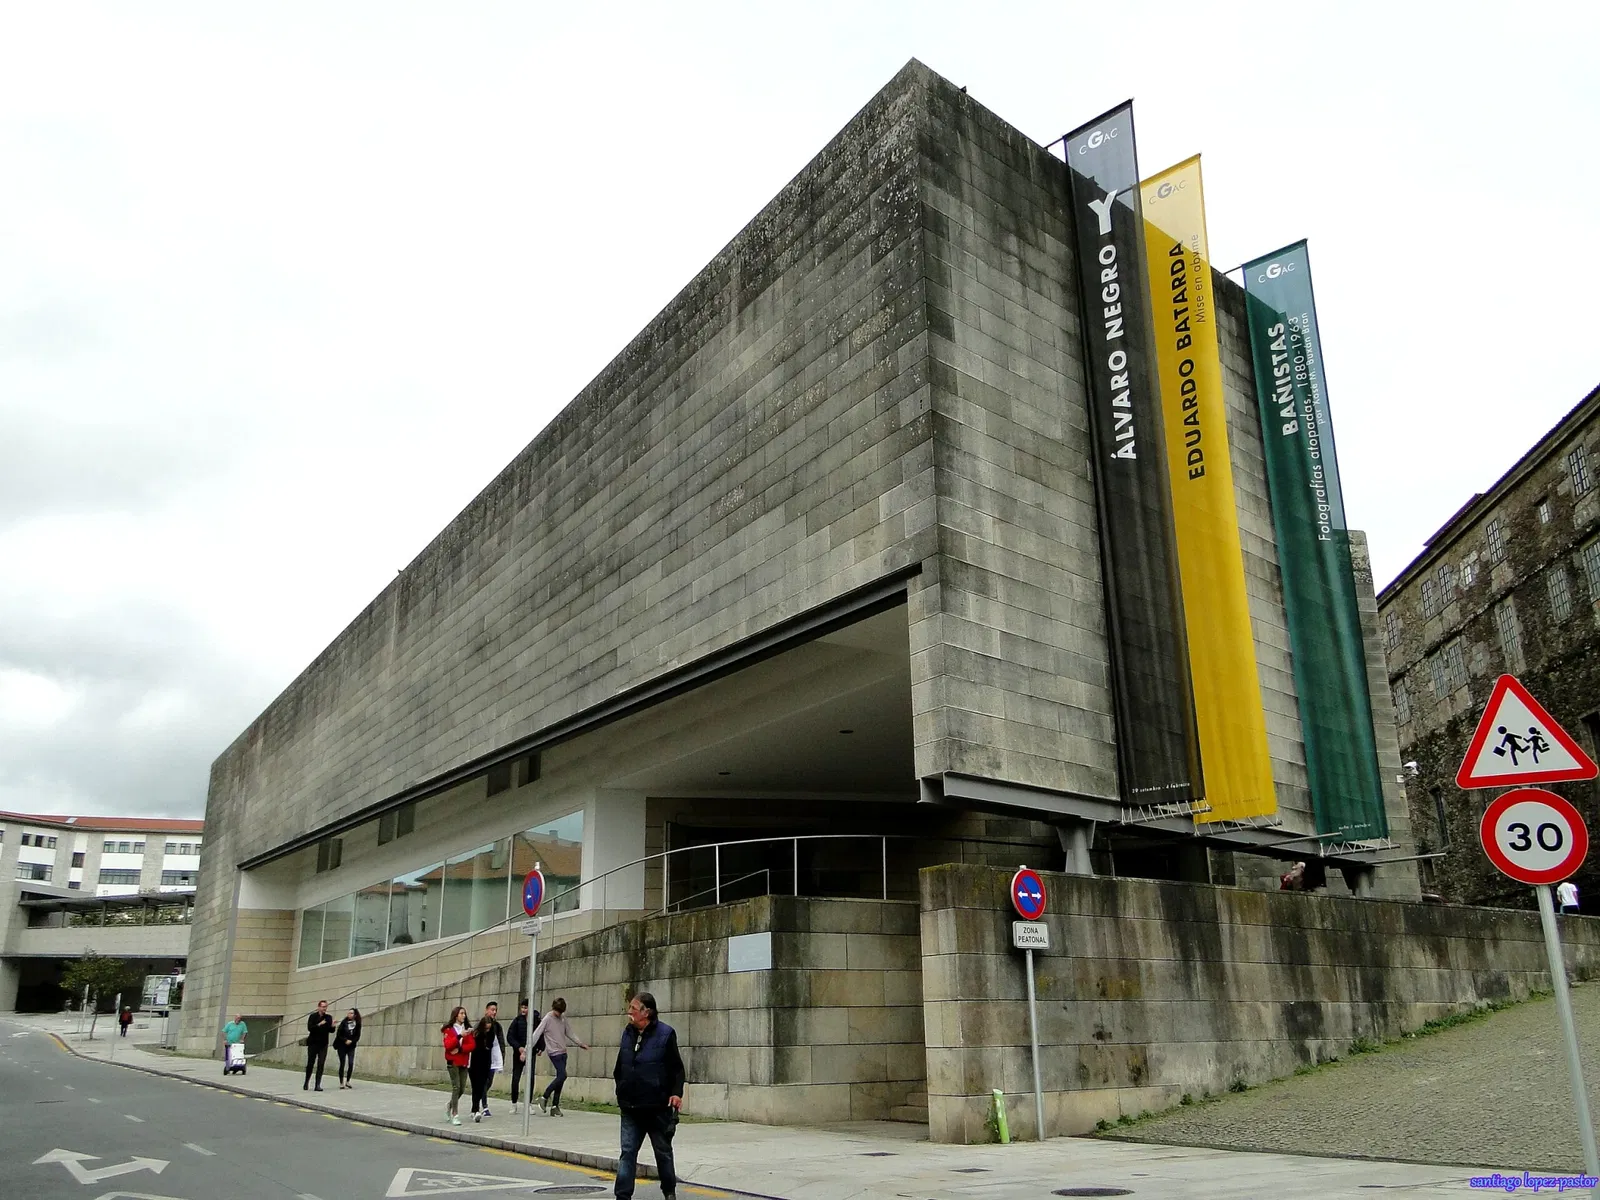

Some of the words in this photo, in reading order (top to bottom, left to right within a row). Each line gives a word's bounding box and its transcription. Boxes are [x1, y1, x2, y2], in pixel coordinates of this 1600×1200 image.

[1079, 128, 1118, 155] CGAC
[1149, 180, 1186, 205] CGAC
[1087, 189, 1118, 236] Y
[1190, 234, 1203, 272] abyme
[1194, 277, 1203, 291] en
[1258, 262, 1295, 283] CGAC
[1098, 244, 1124, 341] NEGRO
[1169, 240, 1193, 351] BATARDA
[1194, 296, 1206, 323] Mise
[1301, 312, 1309, 335] Bran
[1288, 316, 1308, 388] 1880-1963
[1268, 323, 1299, 436] BAÑISTAS
[1110, 350, 1137, 460] ÁLVARO
[1178, 358, 1206, 481] EDUARDO
[1316, 409, 1326, 425] por
[1300, 394, 1319, 459] atopadas,
[1309, 464, 1331, 541] Fotografías
[1507, 822, 1563, 852] 30
[1018, 935, 1047, 943] PEATONAL
